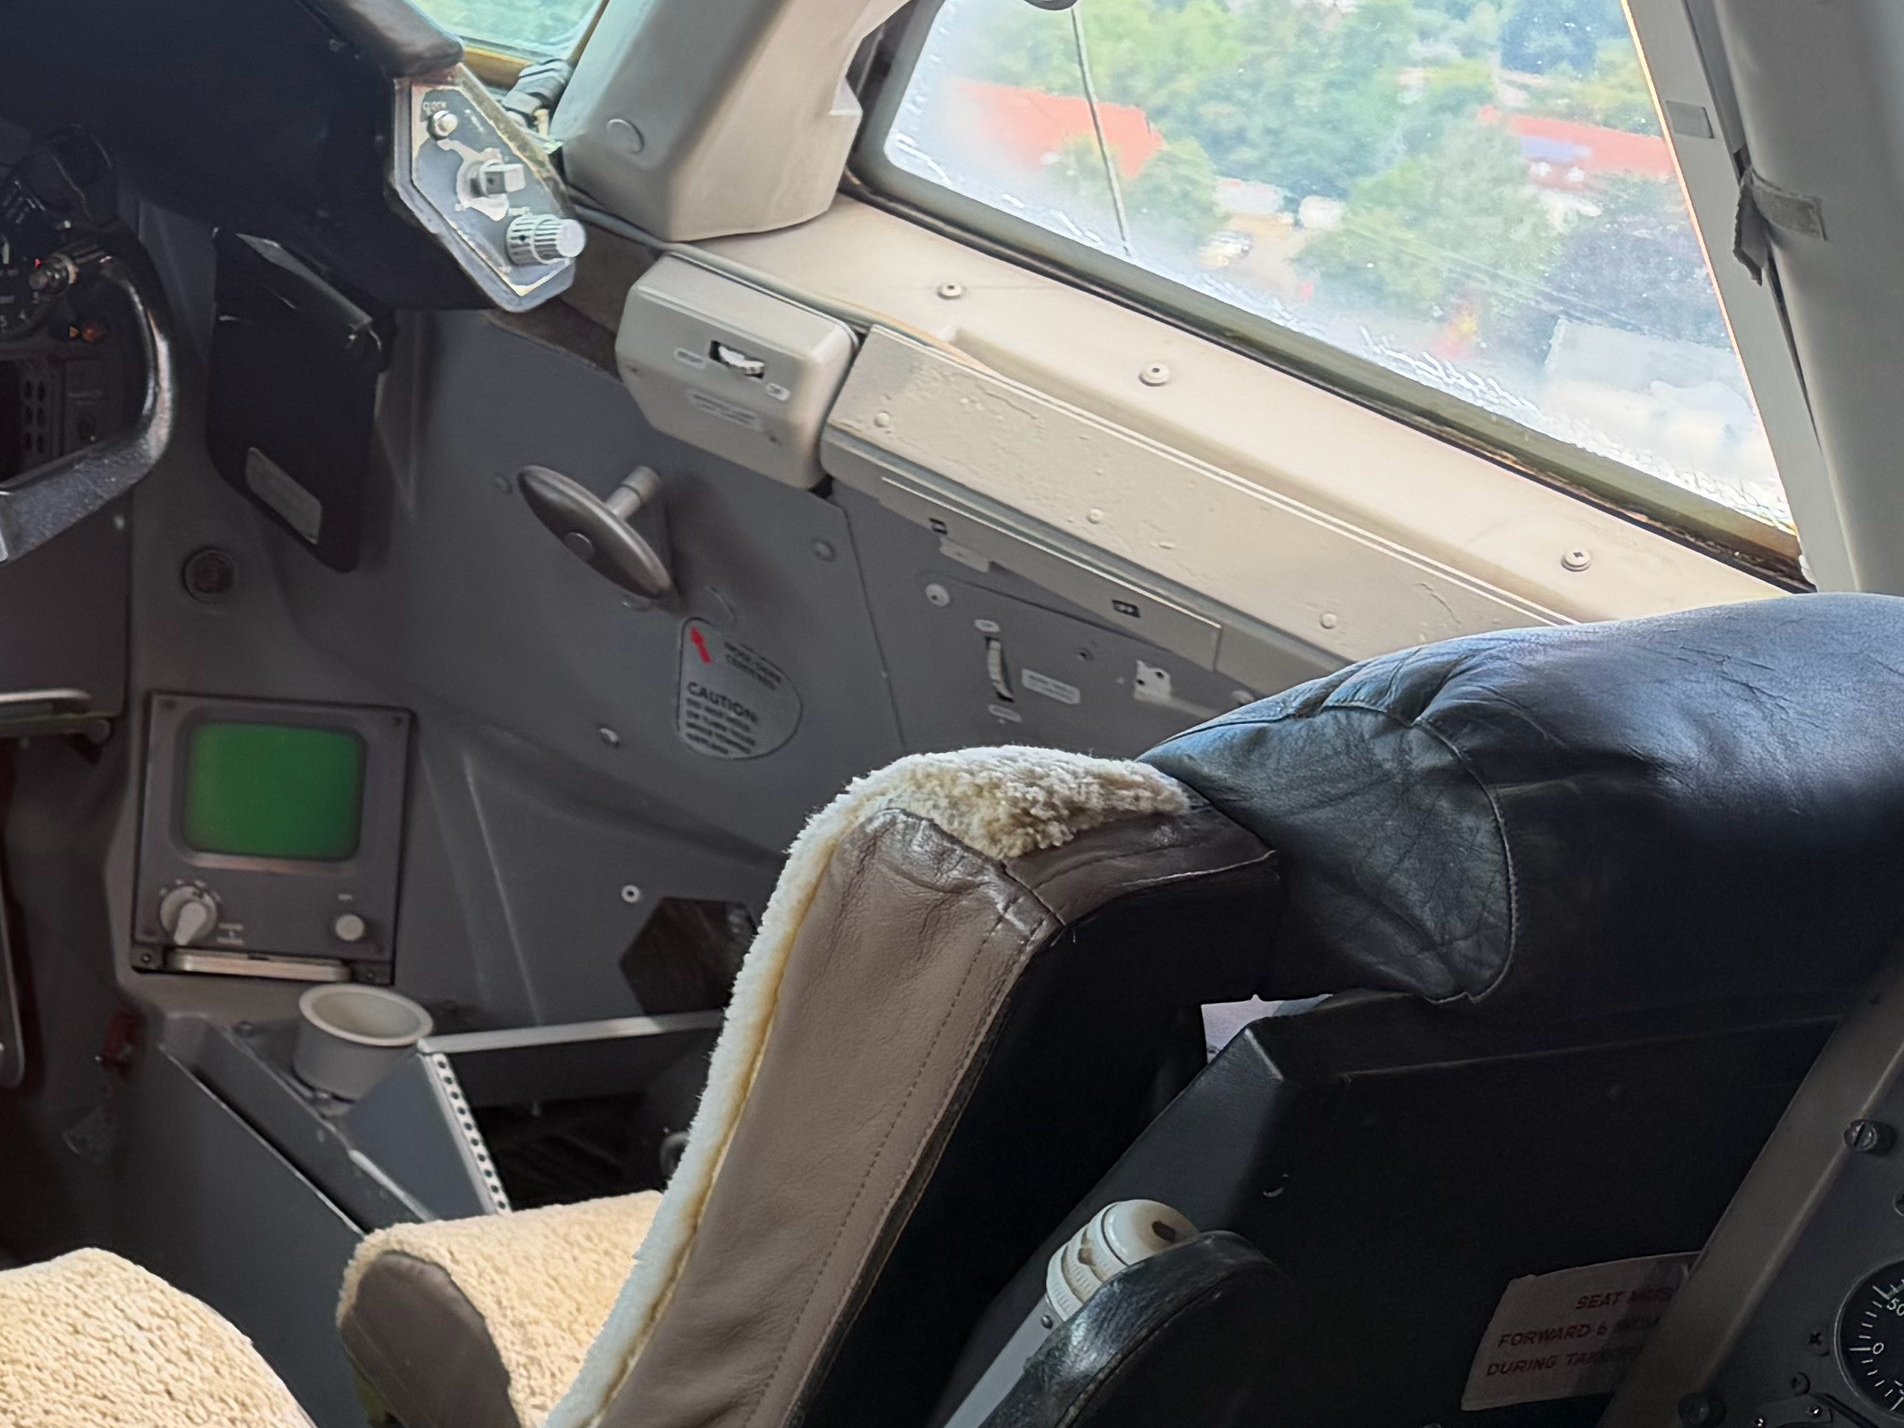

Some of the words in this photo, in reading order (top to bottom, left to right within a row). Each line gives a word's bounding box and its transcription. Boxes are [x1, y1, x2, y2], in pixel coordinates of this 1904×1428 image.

[1576, 1292, 1624, 1310] SEAT
[1498, 1323, 1591, 1347] FORWARD
[1597, 1321, 1608, 1336] 6
[1873, 1341, 1884, 1355] 0
[1486, 1355, 1558, 1375] DURING
